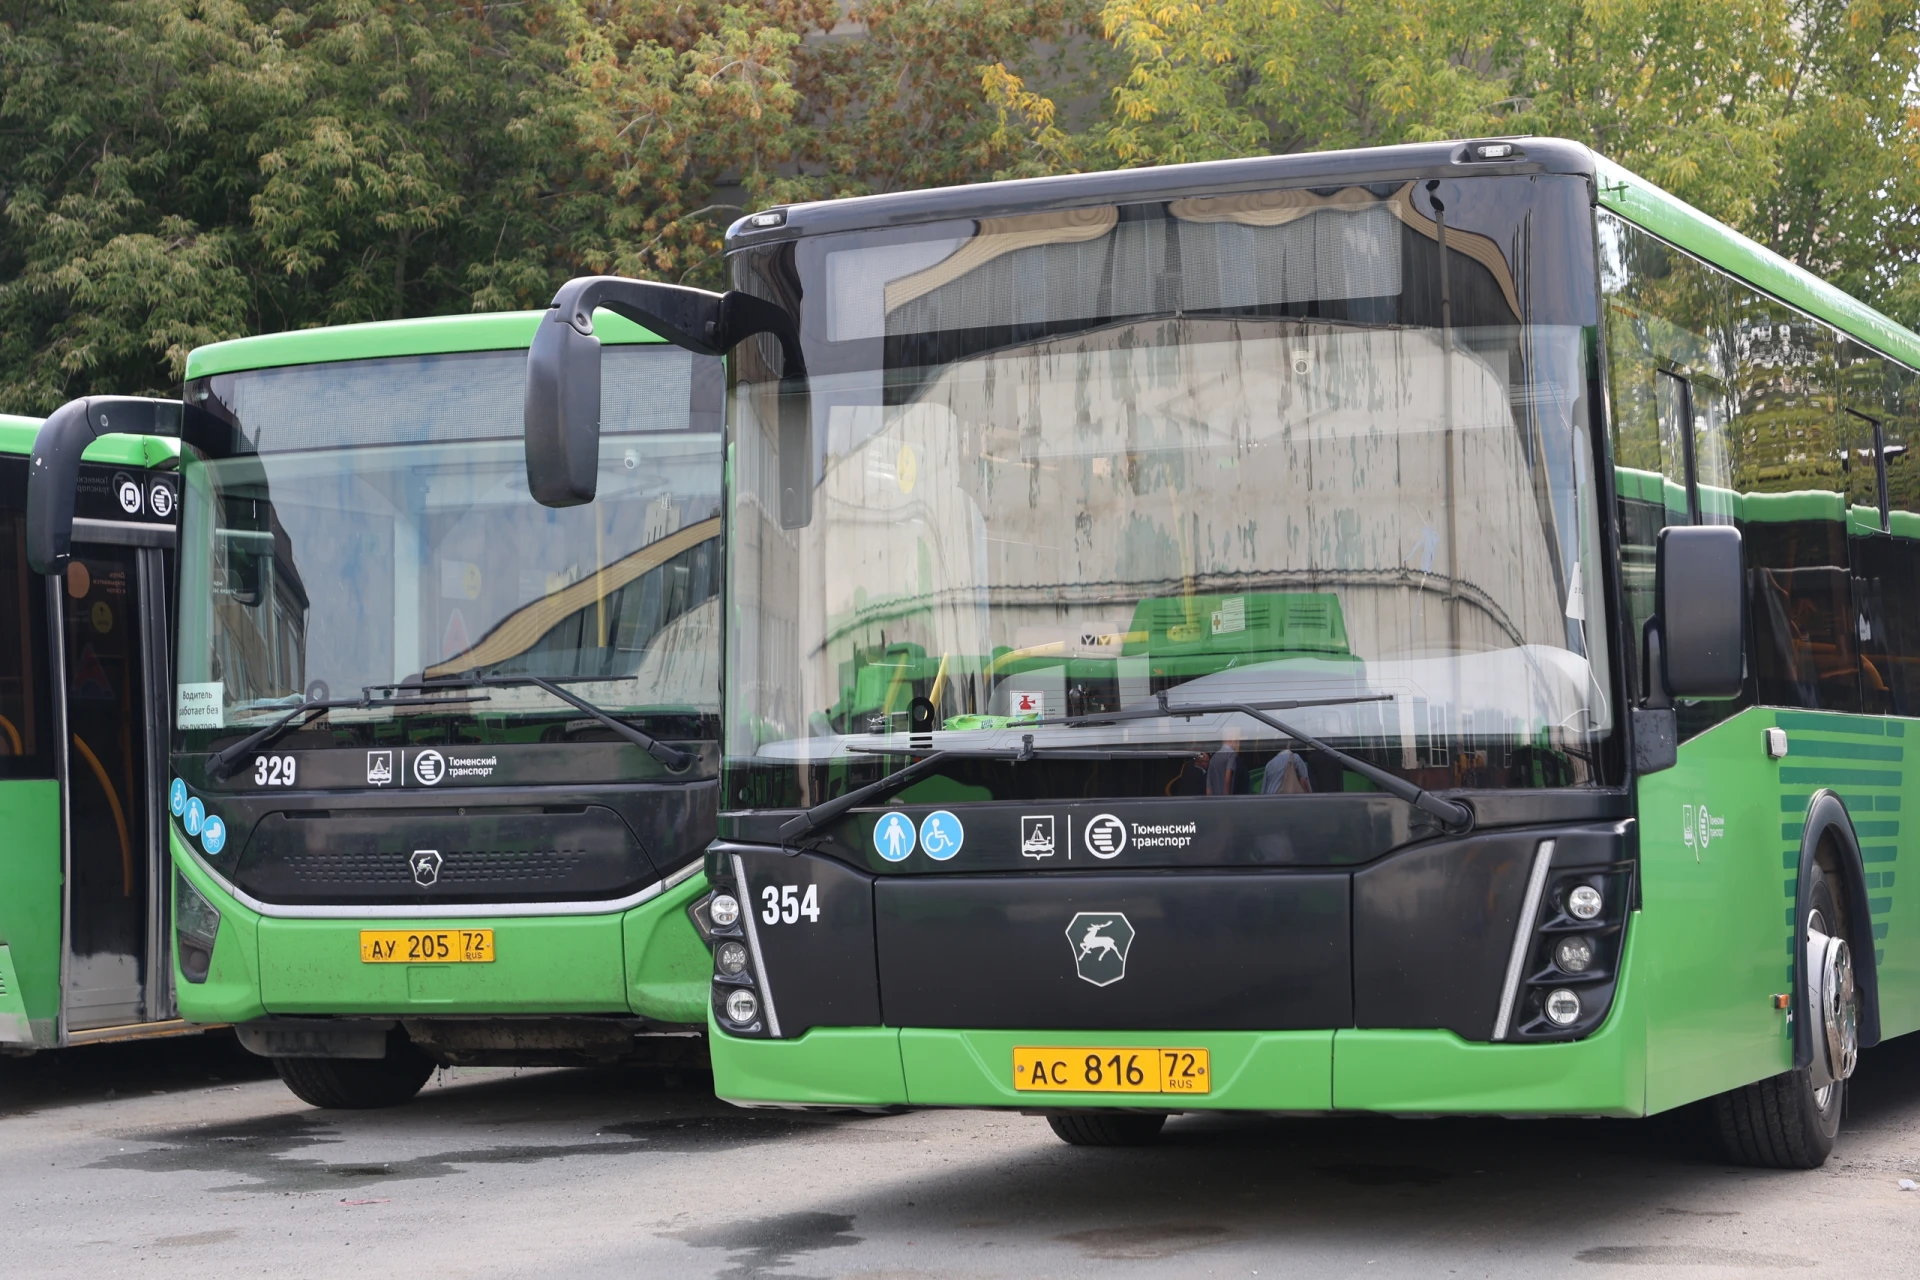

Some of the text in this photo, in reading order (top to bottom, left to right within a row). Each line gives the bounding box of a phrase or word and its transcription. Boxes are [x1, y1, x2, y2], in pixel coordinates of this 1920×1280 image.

[182, 690, 213, 702] Водитель
[206, 704, 219, 715] без
[448, 755, 497, 767] Тюменский
[254, 755, 296, 786] 329
[448, 766, 494, 778] транспорт
[1131, 821, 1197, 836] Тюменский
[1131, 836, 1192, 850] транспорт
[761, 883, 821, 926] 354
[407, 934, 450, 958] 205
[462, 933, 485, 951] 72
[465, 952, 484, 960] RUS
[1084, 1054, 1145, 1086] 816
[1164, 1053, 1196, 1078] 72
[1169, 1079, 1193, 1089] RUS
